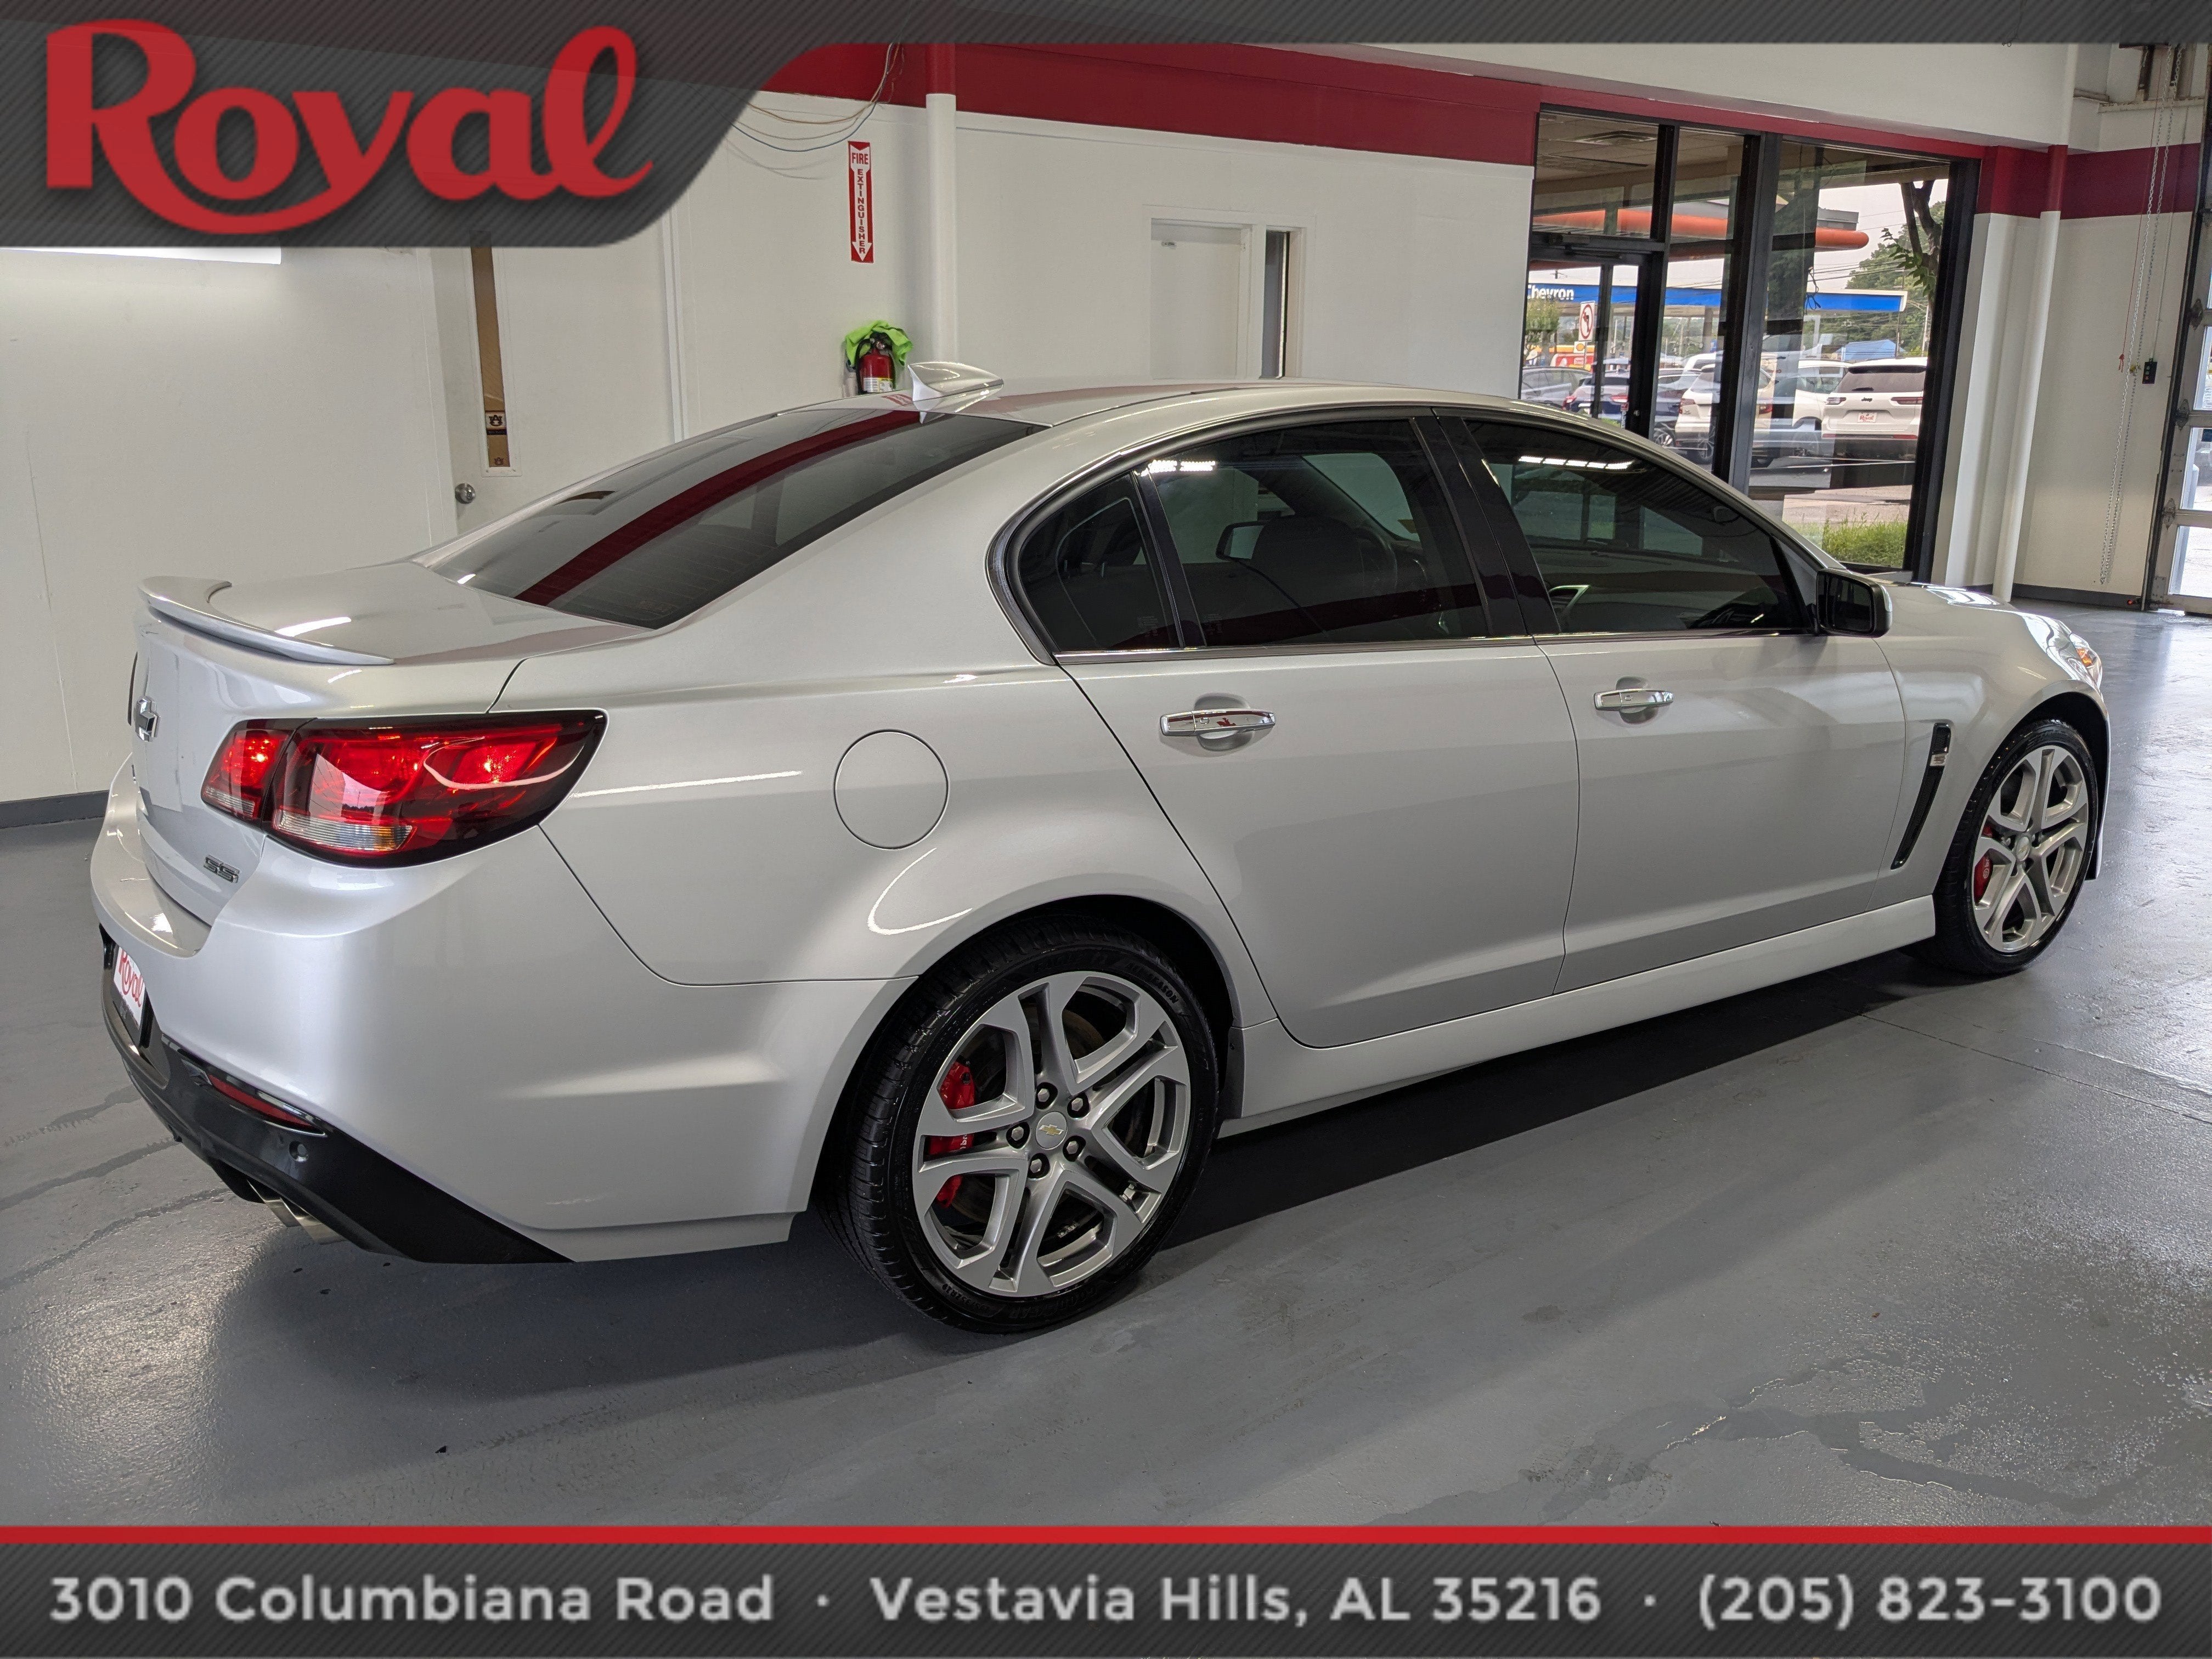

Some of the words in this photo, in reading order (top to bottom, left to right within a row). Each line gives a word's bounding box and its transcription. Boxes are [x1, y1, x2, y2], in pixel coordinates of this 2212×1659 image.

[851, 153, 869, 165] FIRE
[857, 168, 866, 254] EXTINGUISHER
[204, 854, 240, 883] SS
